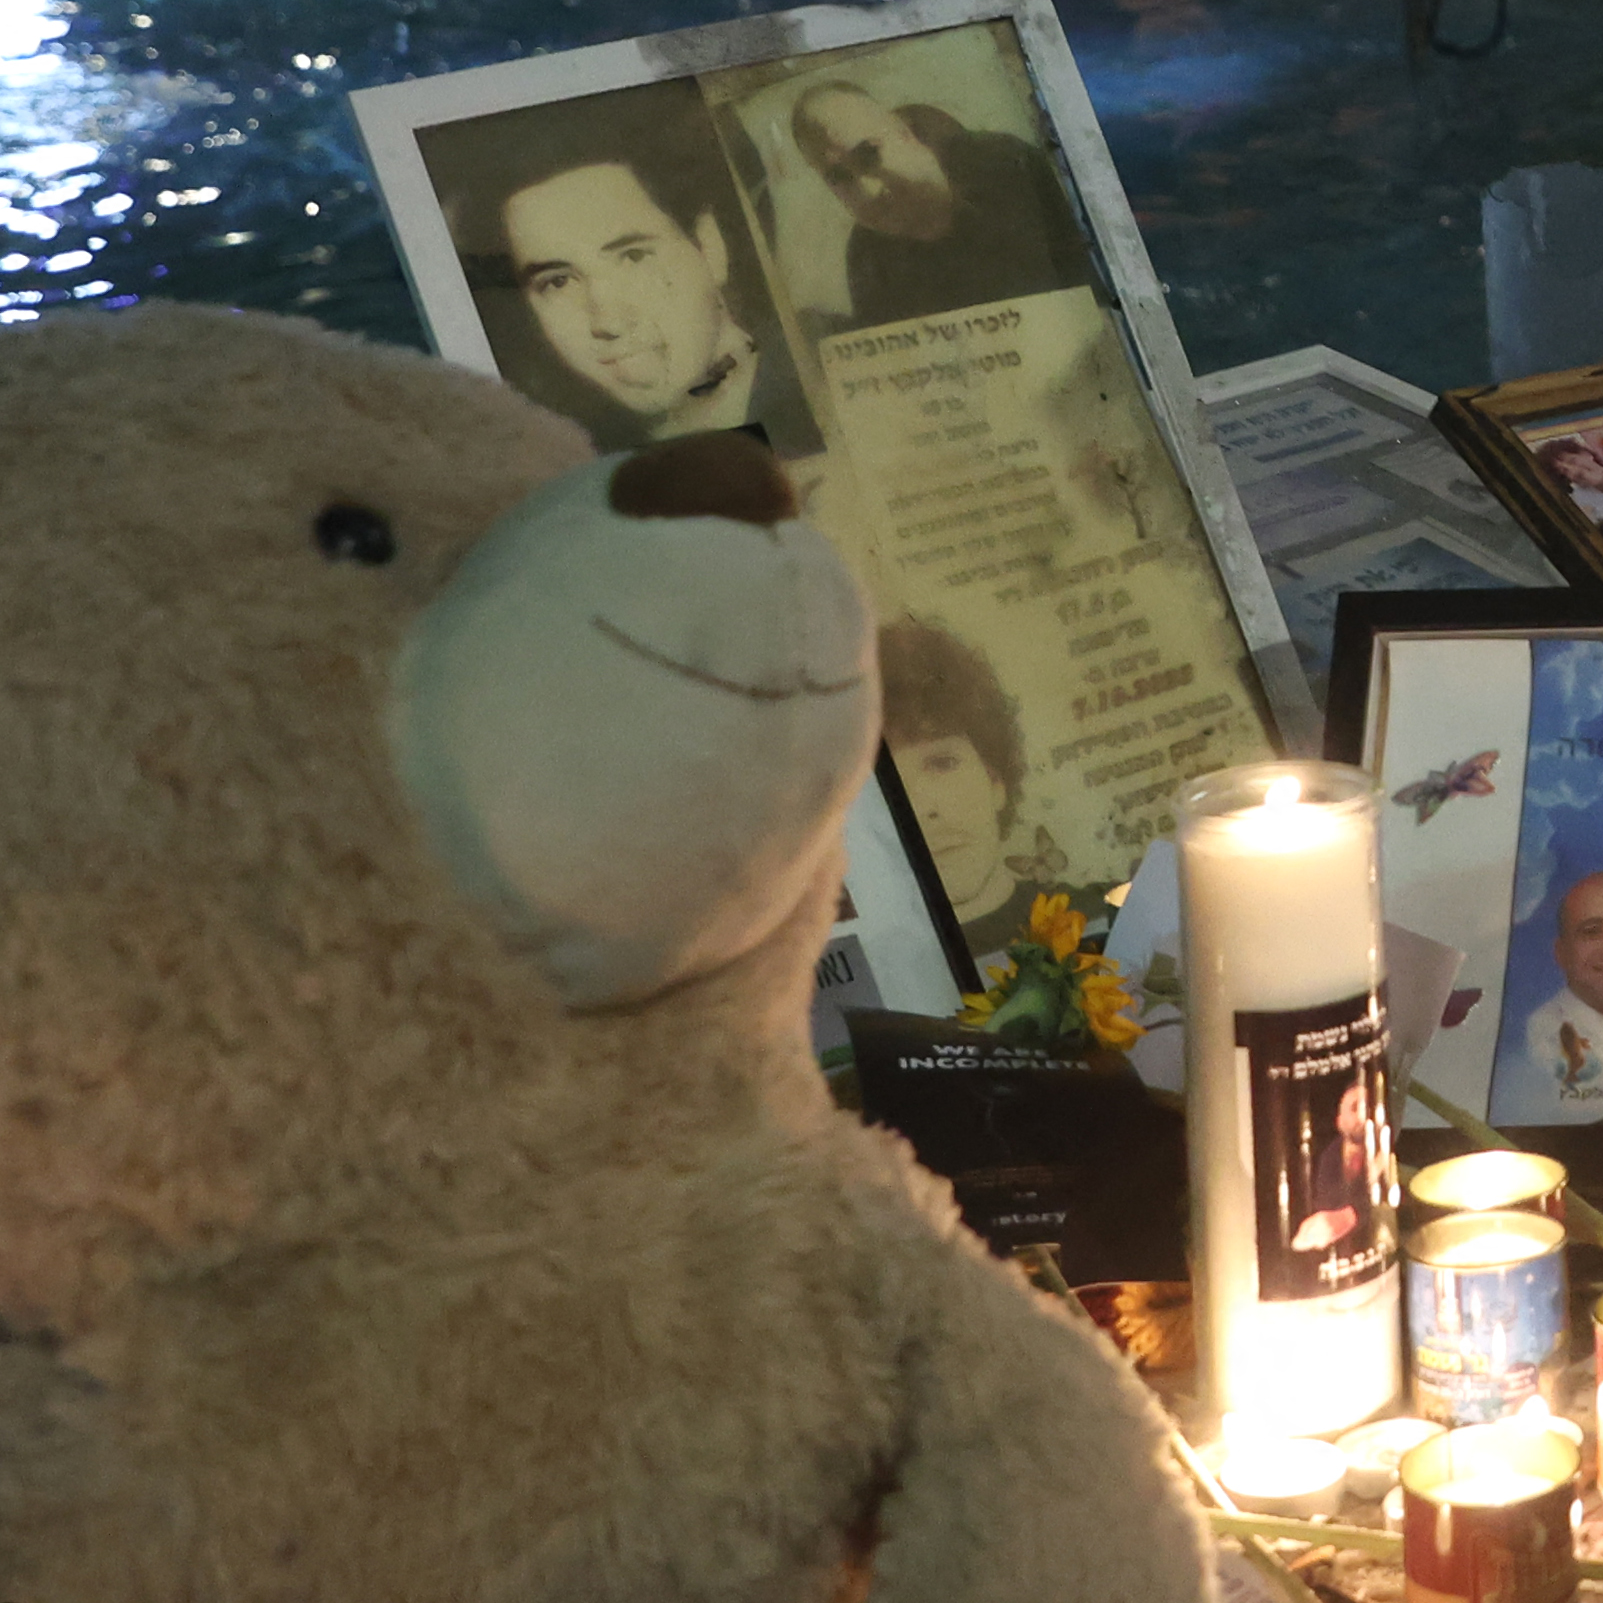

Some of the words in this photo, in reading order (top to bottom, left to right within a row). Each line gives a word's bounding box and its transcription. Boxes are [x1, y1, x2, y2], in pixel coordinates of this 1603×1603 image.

[966, 307, 1022, 334] לזכרו
[922, 322, 958, 343] של
[898, 1056, 1092, 1071] INCOMPLETE
